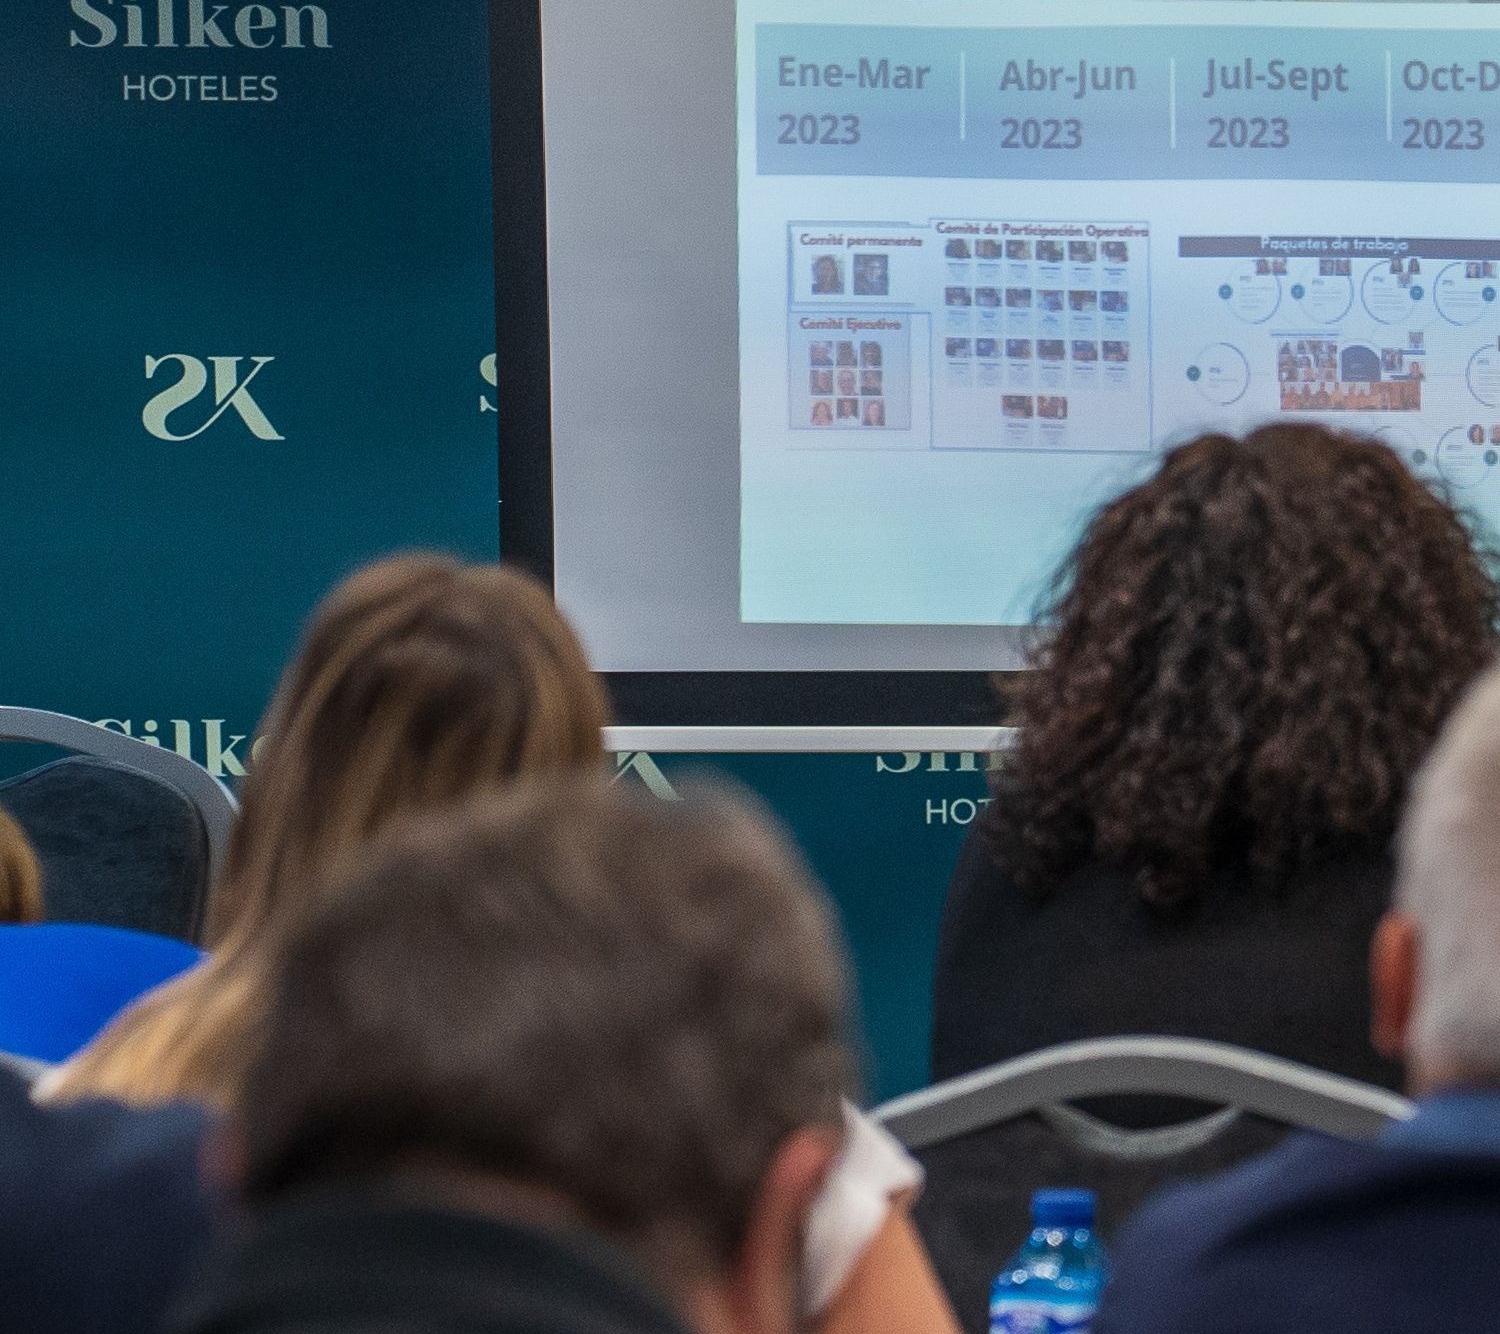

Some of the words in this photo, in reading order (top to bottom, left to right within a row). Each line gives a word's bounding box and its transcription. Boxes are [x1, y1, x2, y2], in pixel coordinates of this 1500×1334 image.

[123, 75, 278, 102] HOTELES
[777, 55, 931, 91] Ene-Mar
[1000, 59, 1136, 99] Abr-Jun
[1204, 57, 1348, 101] Jul-Sept
[777, 114, 861, 146] 2023
[1001, 118, 1082, 150] 2023
[1207, 117, 1290, 149] 2023
[1403, 118, 1484, 151] 2023
[1261, 237, 1328, 253] Paquetes
[1332, 237, 1348, 251] de
[1353, 237, 1409, 253] trabajo
